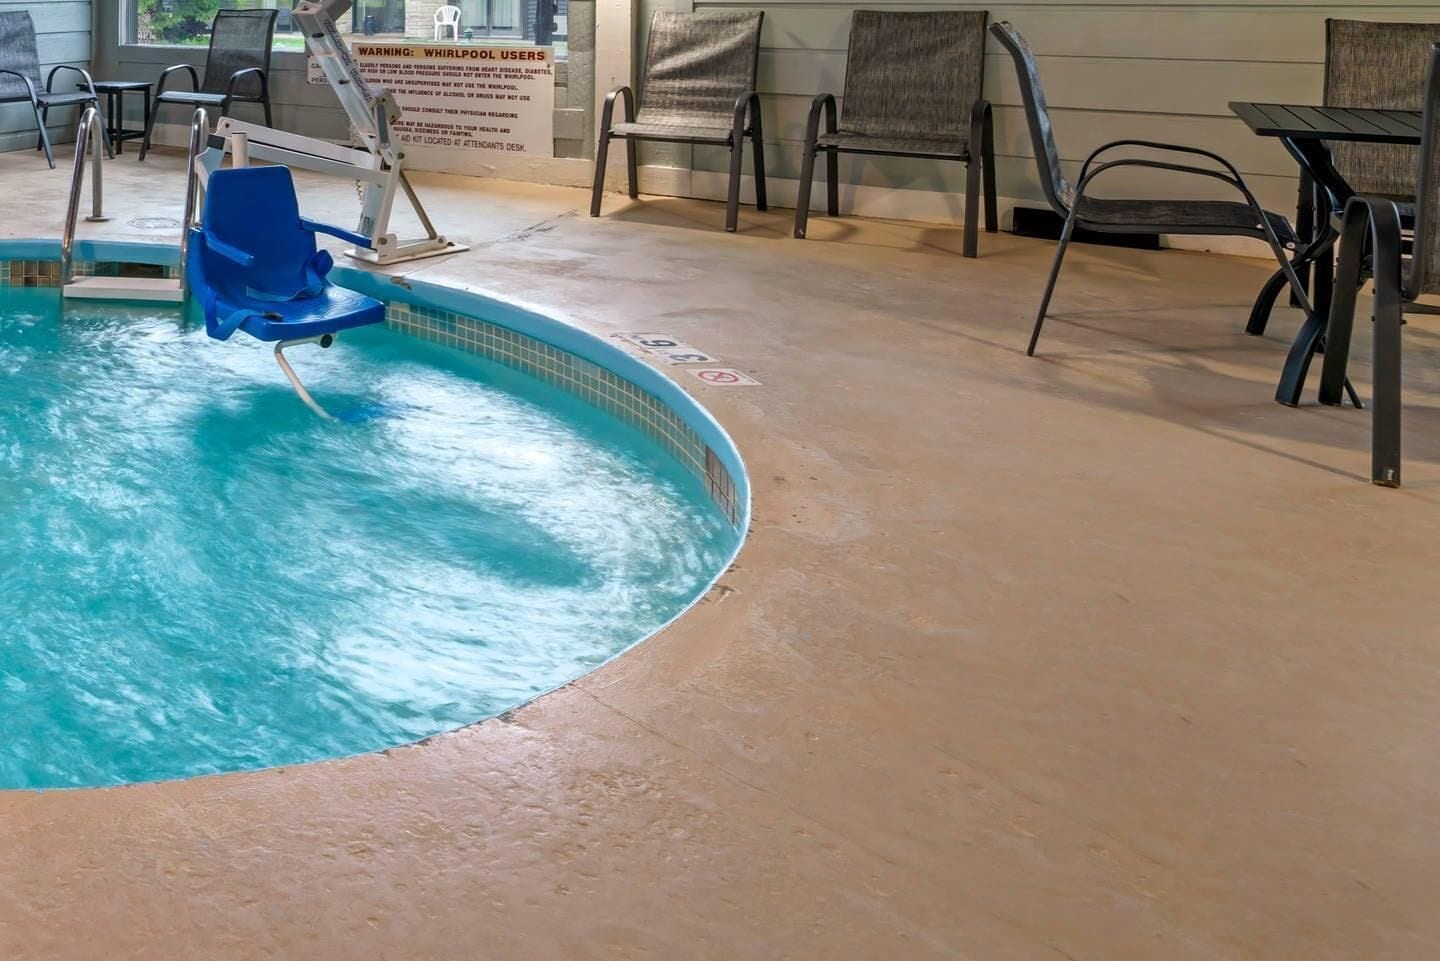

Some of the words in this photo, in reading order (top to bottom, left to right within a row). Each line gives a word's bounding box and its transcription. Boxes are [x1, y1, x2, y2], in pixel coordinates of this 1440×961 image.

[359, 47, 414, 57] WARNING:
[424, 48, 495, 59] WHIRLPOOL
[500, 51, 545, 60] USERS
[525, 68, 552, 76] DIABETES,
[424, 122, 454, 130] HAZARDOUS
[401, 134, 411, 142] AID
[424, 137, 452, 146] LOCATED
[506, 143, 526, 152] DESK.
[640, 339, 678, 347] 6
